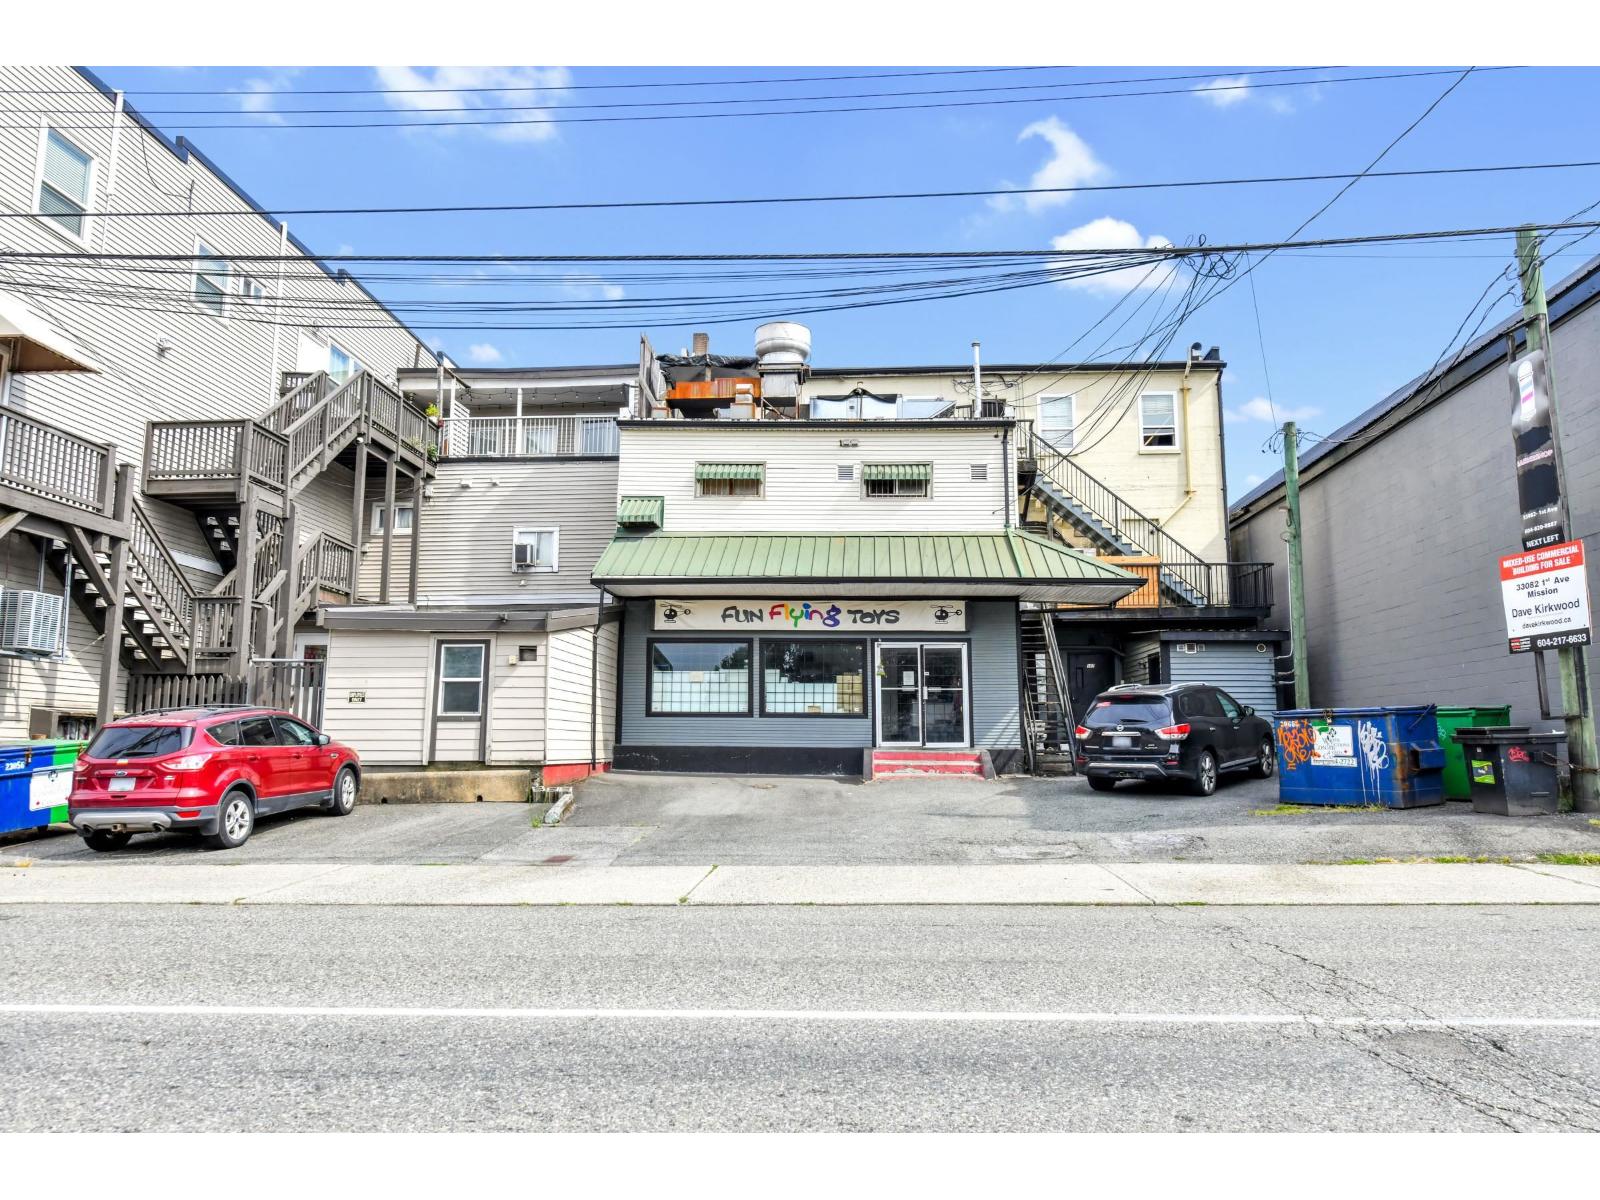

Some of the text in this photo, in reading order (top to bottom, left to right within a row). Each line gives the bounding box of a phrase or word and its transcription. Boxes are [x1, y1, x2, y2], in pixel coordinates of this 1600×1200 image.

[1526, 533, 1560, 548] NEXT LEFT
[1502, 545, 1580, 568] MIXED-USE COMMERCIAL
[1512, 557, 1571, 575] BUILDING FOR SALE
[1516, 575, 1570, 591] 33082 1st Ave
[1527, 586, 1558, 598] Mission
[721, 602, 901, 628] FUN Flying TOYS
[1512, 598, 1580, 618] Dave Kirkwood
[1522, 616, 1572, 629] davekirkwood.ca
